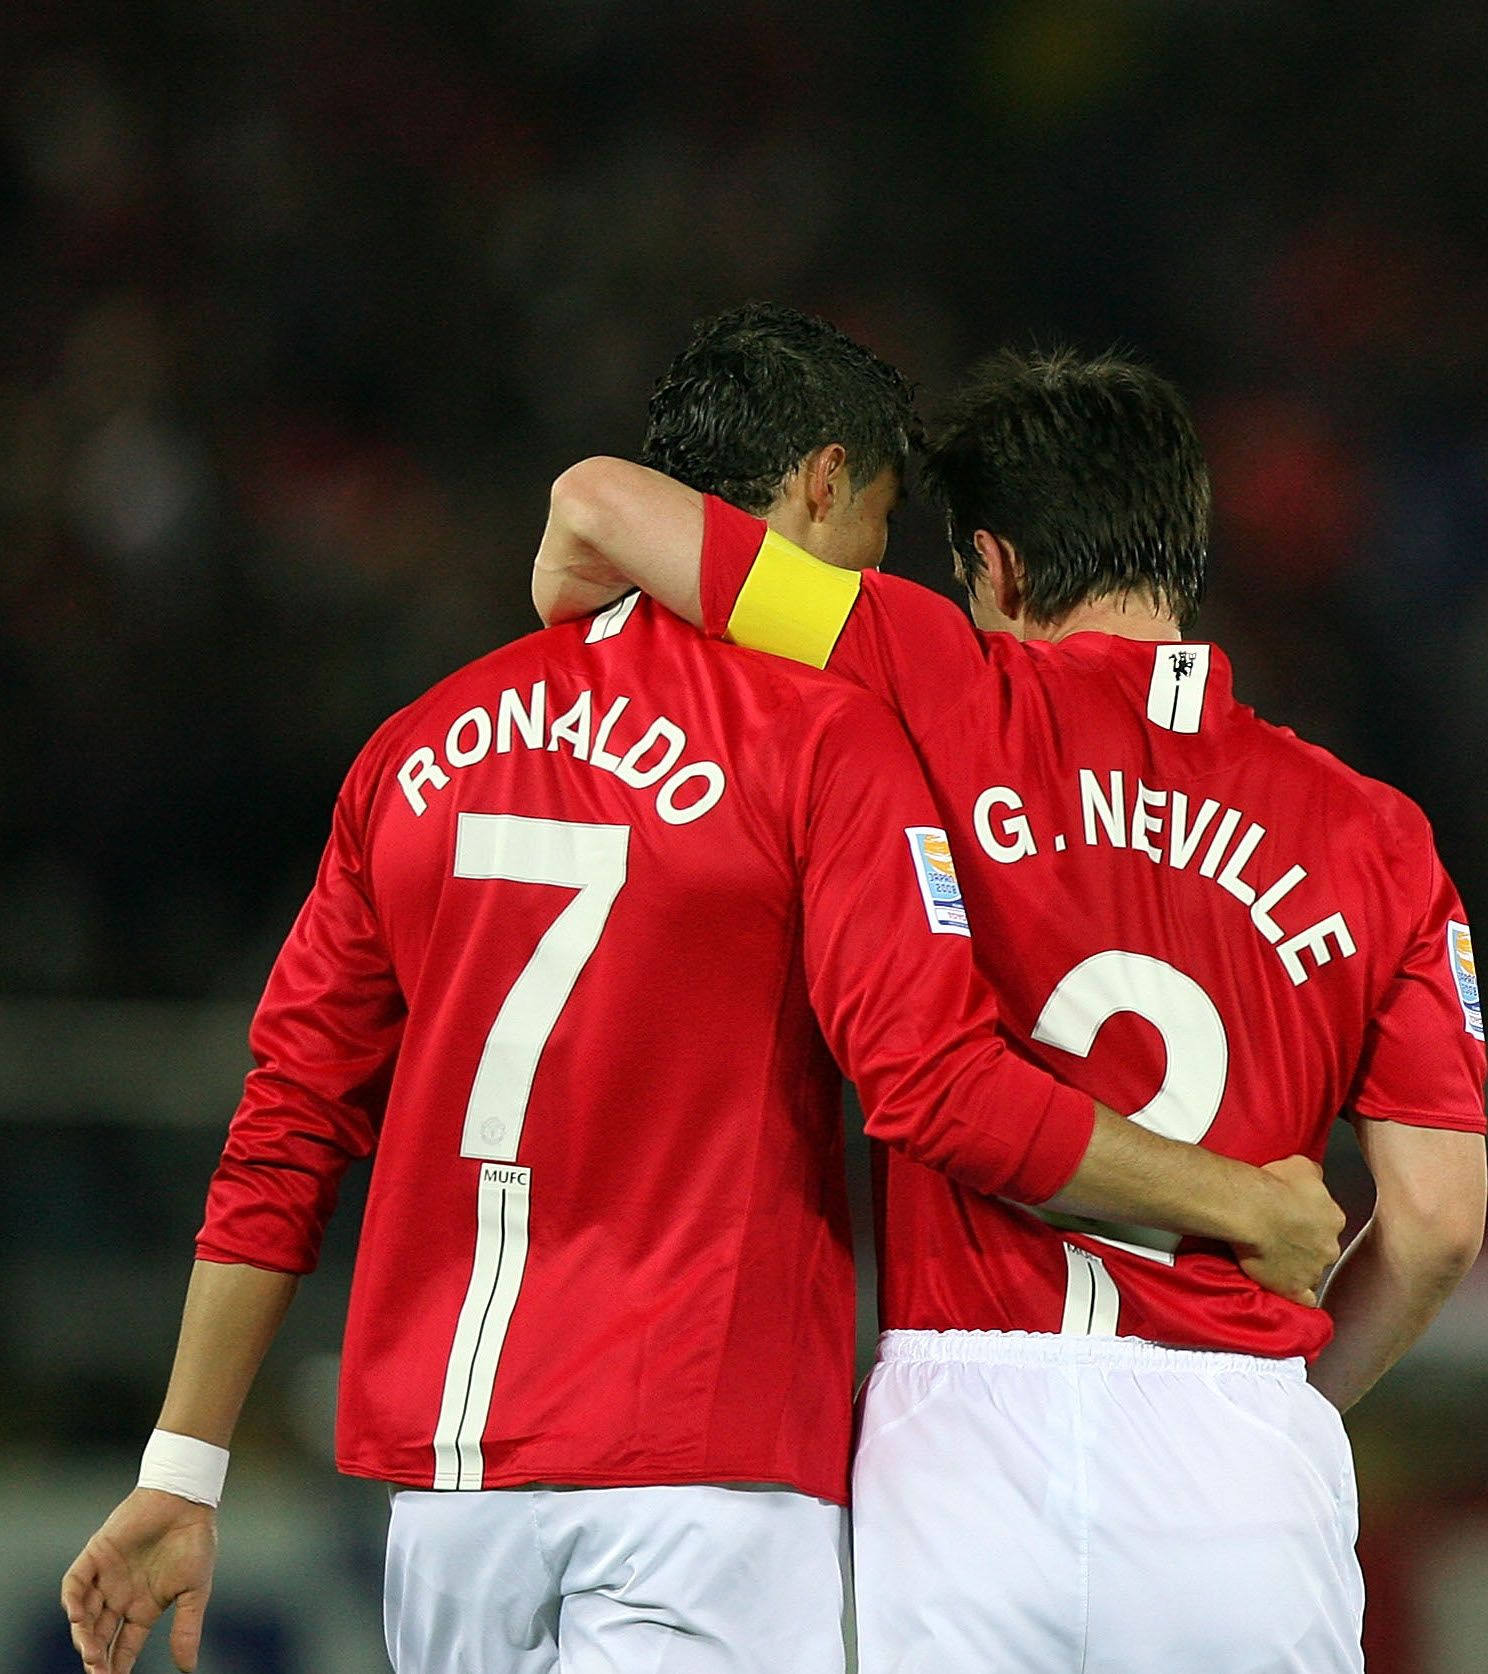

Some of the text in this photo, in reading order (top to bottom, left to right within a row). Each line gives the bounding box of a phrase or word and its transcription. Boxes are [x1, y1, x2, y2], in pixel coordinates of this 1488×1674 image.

[396, 680, 725, 825] RONALDO
[454, 812, 631, 1162] 7
[1079, 768, 1357, 987] NEVILLE
[484, 1169, 528, 1186] MUFC
[1005, 950, 1228, 1267] 2
